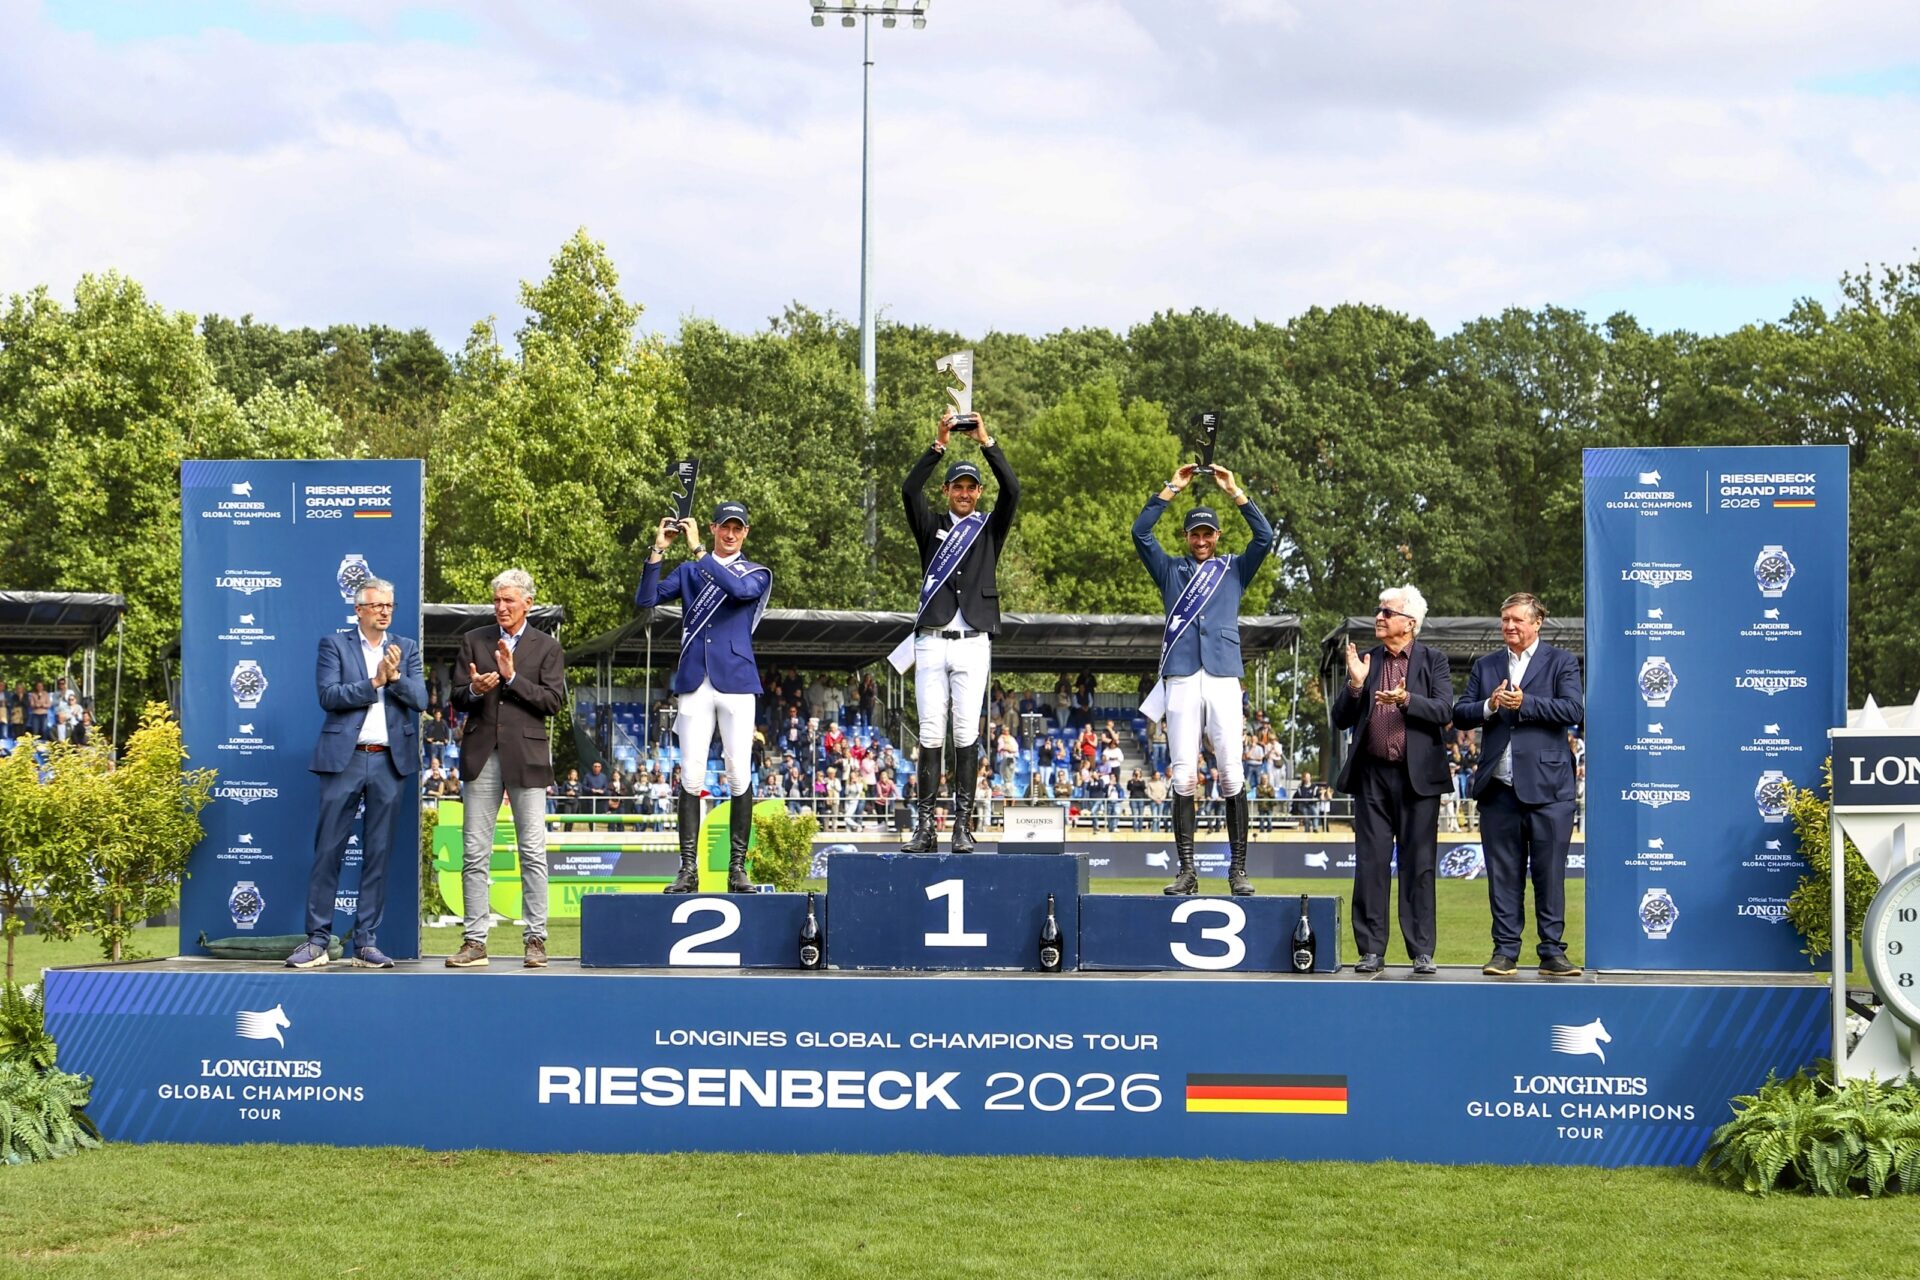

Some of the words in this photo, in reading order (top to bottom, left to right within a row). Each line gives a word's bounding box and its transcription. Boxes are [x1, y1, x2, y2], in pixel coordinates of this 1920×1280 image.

[1720, 473, 1816, 483] RIESENBECK
[306, 486, 391, 495] RIESENBECK
[1720, 486, 1774, 496] GRAND
[1779, 486, 1815, 495] PRIX
[306, 498, 355, 506] GRAND
[359, 498, 391, 506] PRIX
[1720, 499, 1760, 509] 2026
[306, 510, 342, 519] 2026
[1622, 570, 1692, 580] LONGINES
[216, 578, 281, 587] LONGINES
[1736, 677, 1807, 688] LONGINES
[214, 788, 278, 798] LONGINES
[1621, 790, 1690, 800] LONGINES
[925, 879, 987, 947] 1
[1898, 908, 1917, 922] 10
[669, 898, 741, 966] 2
[1170, 898, 1247, 970] 3
[1888, 941, 1903, 955] 9
[1898, 973, 1914, 987] 8
[656, 1030, 787, 1047] LONGINES
[796, 1032, 900, 1048] GLOBAL
[910, 1033, 1073, 1049] CHAMPIONS
[1083, 1034, 1158, 1050] TOUR
[201, 1060, 321, 1078] LONGINES
[538, 1066, 961, 1110] RIESENBECK
[984, 1072, 1163, 1112] 2026
[1514, 1076, 1647, 1095] LONGINES
[158, 1085, 235, 1100] GLOBAL
[243, 1086, 364, 1101] CHAMPIONS
[239, 1108, 280, 1120] TOUR
[1467, 1102, 1552, 1118] GLOBAL
[1560, 1103, 1695, 1120] CHAMPIONS
[1557, 1127, 1603, 1139] TOUR
